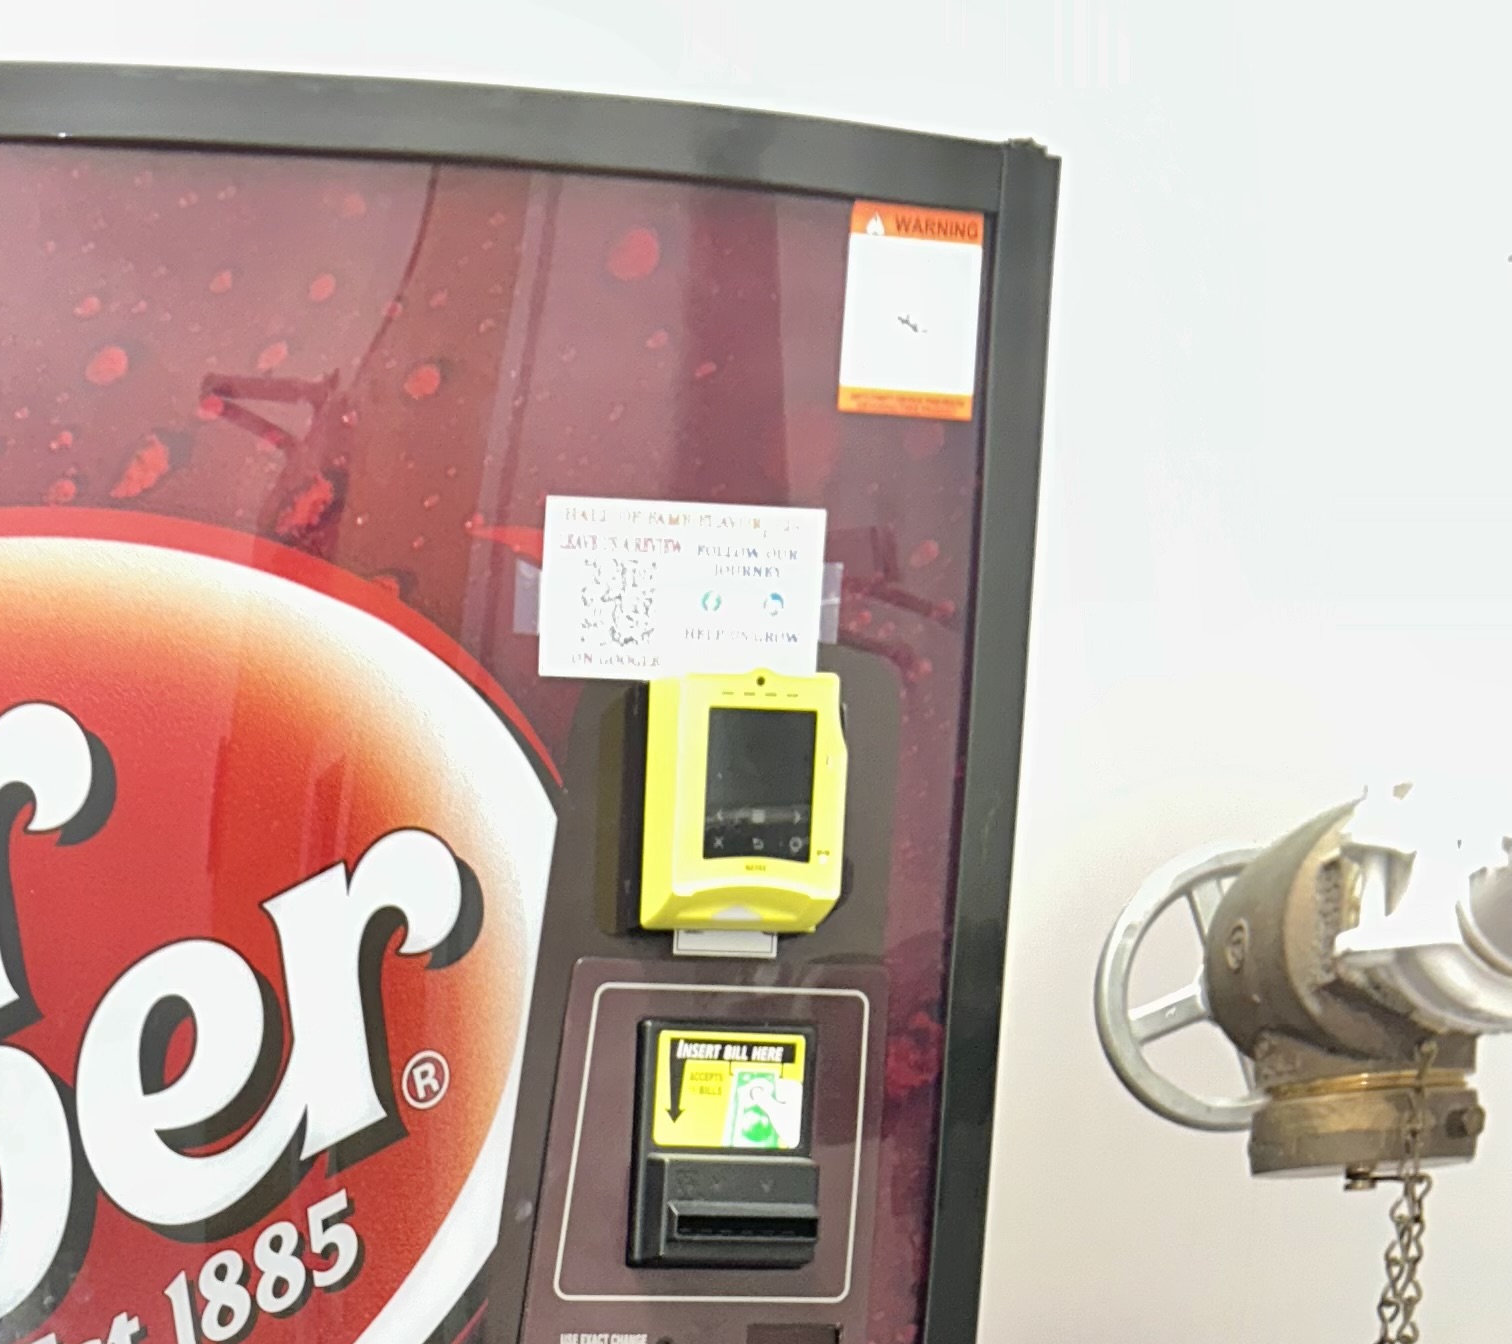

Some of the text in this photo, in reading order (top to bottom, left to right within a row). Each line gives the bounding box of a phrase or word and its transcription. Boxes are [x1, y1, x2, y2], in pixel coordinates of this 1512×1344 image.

[895, 214, 978, 240] WARNING
[696, 544, 759, 559] FOLLOW
[714, 564, 781, 578] JOURNEY
[676, 1039, 784, 1062] INSERT BILL HERE
